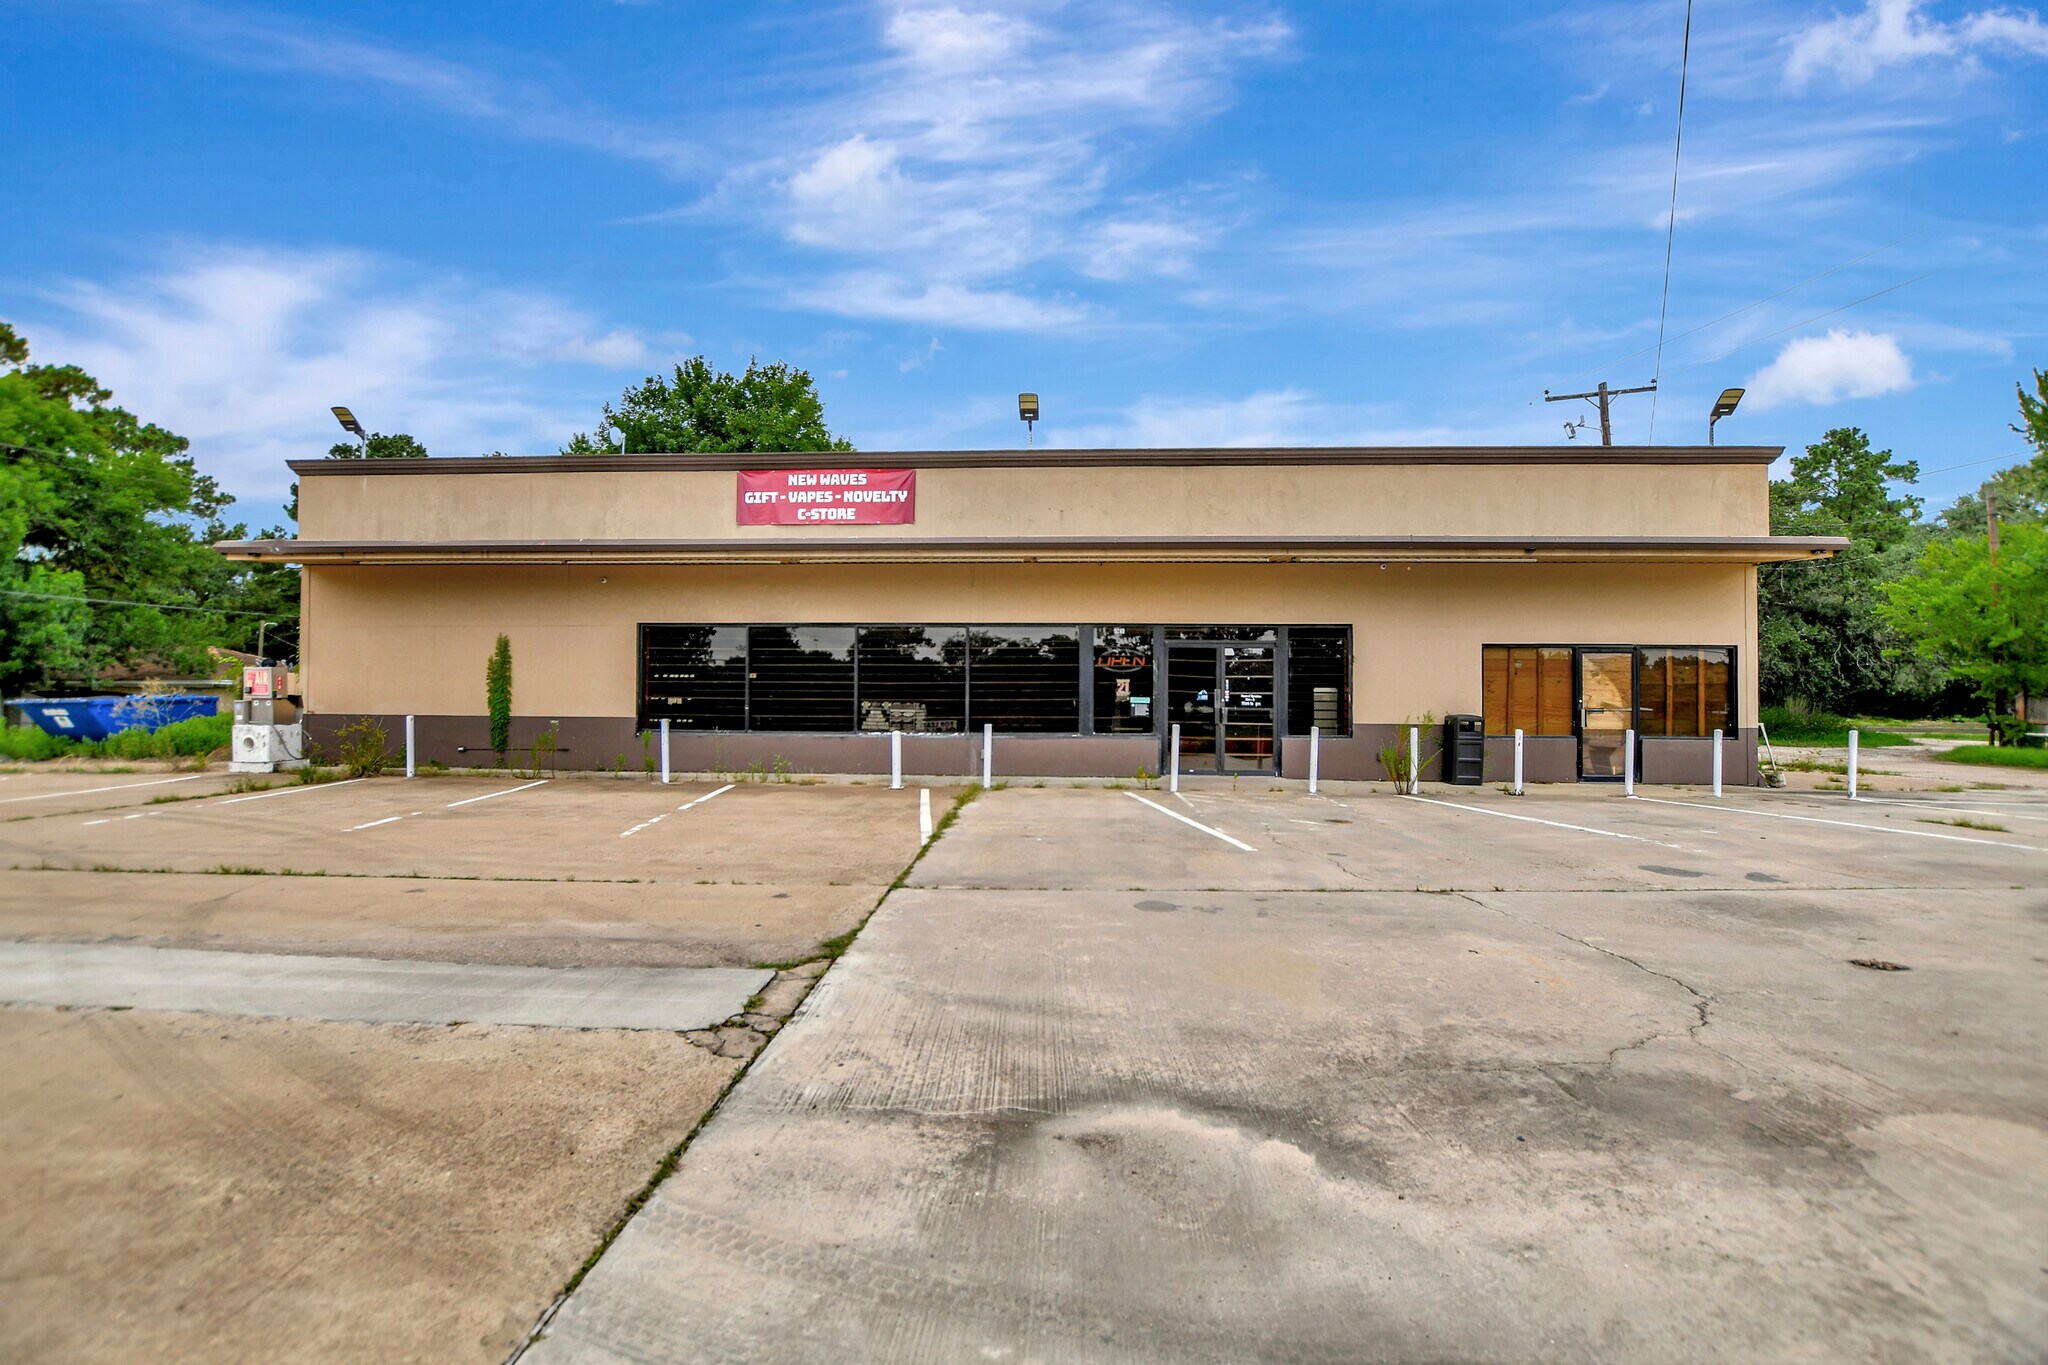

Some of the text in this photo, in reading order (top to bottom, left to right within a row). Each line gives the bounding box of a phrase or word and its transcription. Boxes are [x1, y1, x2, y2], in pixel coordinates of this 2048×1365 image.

[788, 473, 867, 486] NEW WAVES
[744, 491, 779, 504] GIFT
[788, 491, 833, 503] VAPES
[843, 490, 908, 503] NOVELTY
[797, 508, 856, 520] C-STORE
[255, 671, 269, 684] AIR
